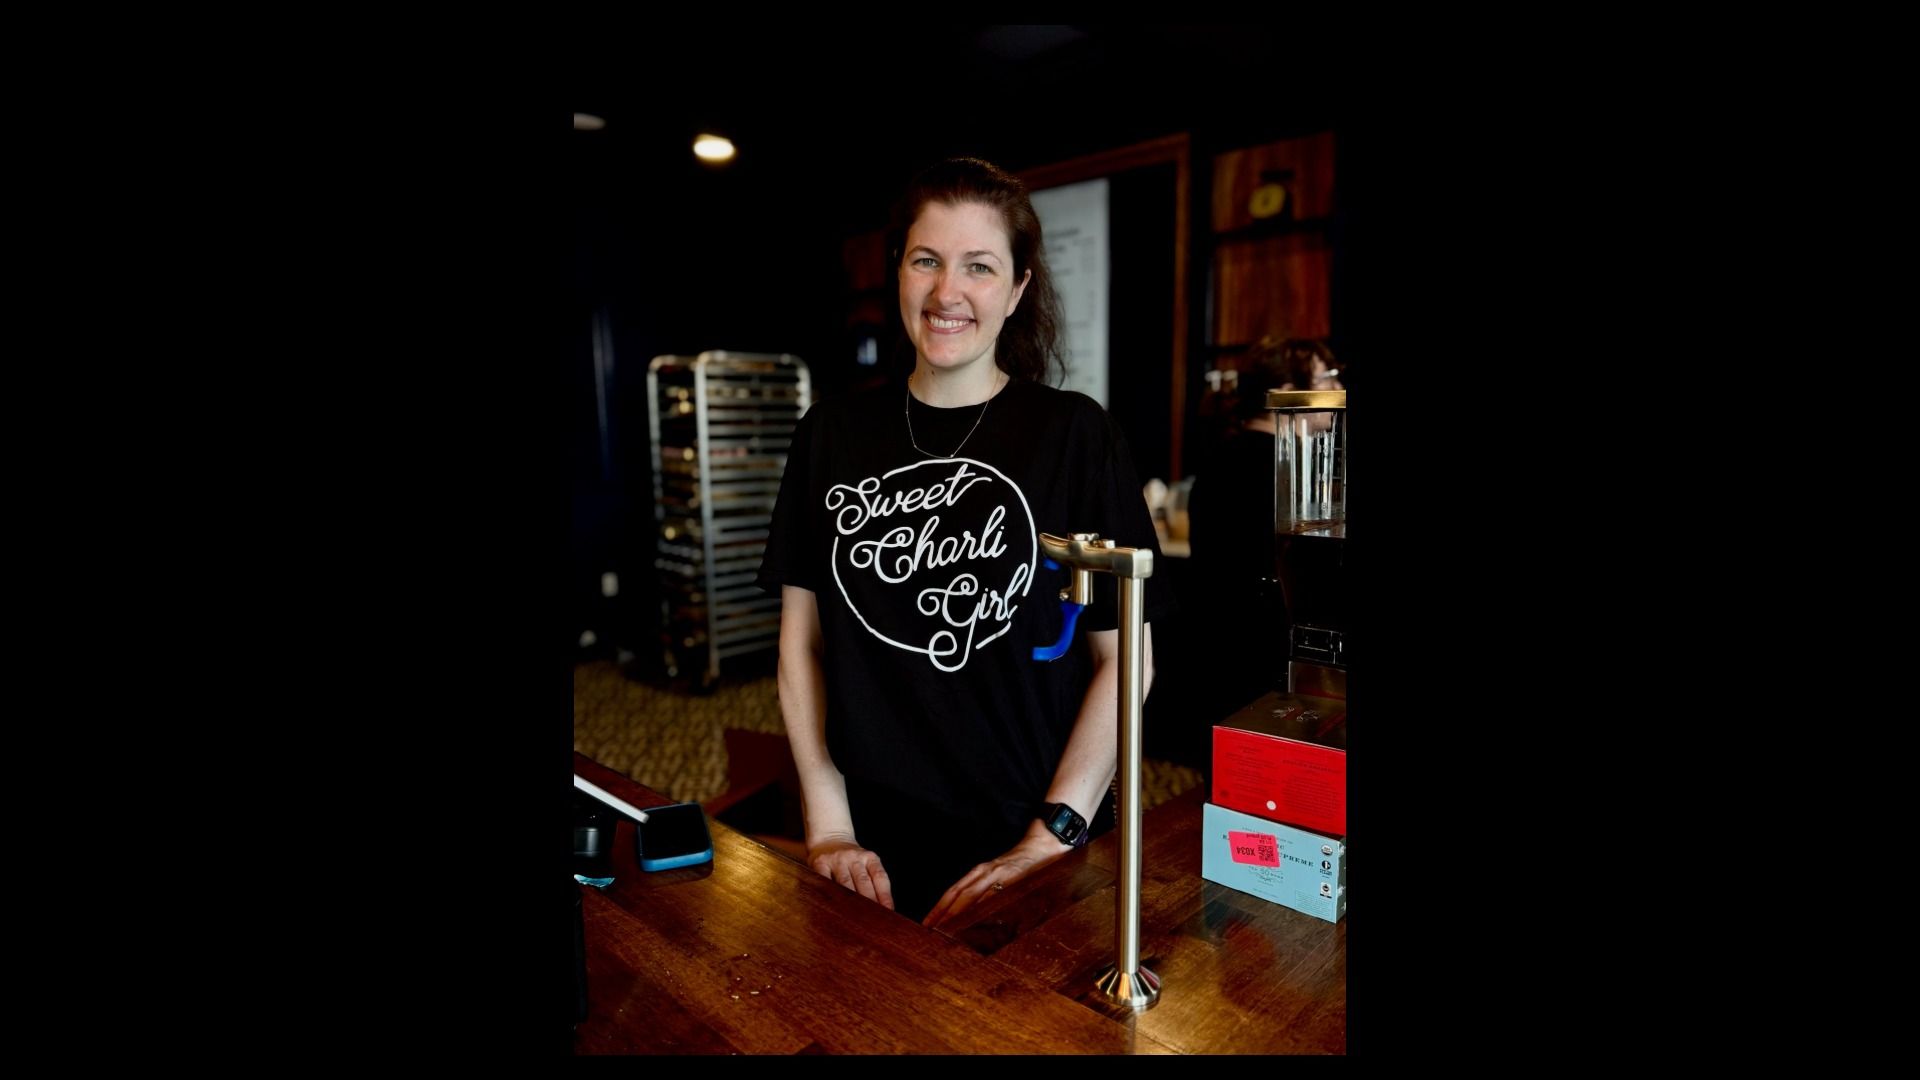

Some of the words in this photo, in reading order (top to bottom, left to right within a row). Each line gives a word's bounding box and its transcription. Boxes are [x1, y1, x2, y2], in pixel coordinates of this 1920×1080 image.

[825, 463, 993, 535] Sweet
[850, 505, 1008, 584] Charli
[916, 563, 1029, 672] Girl
